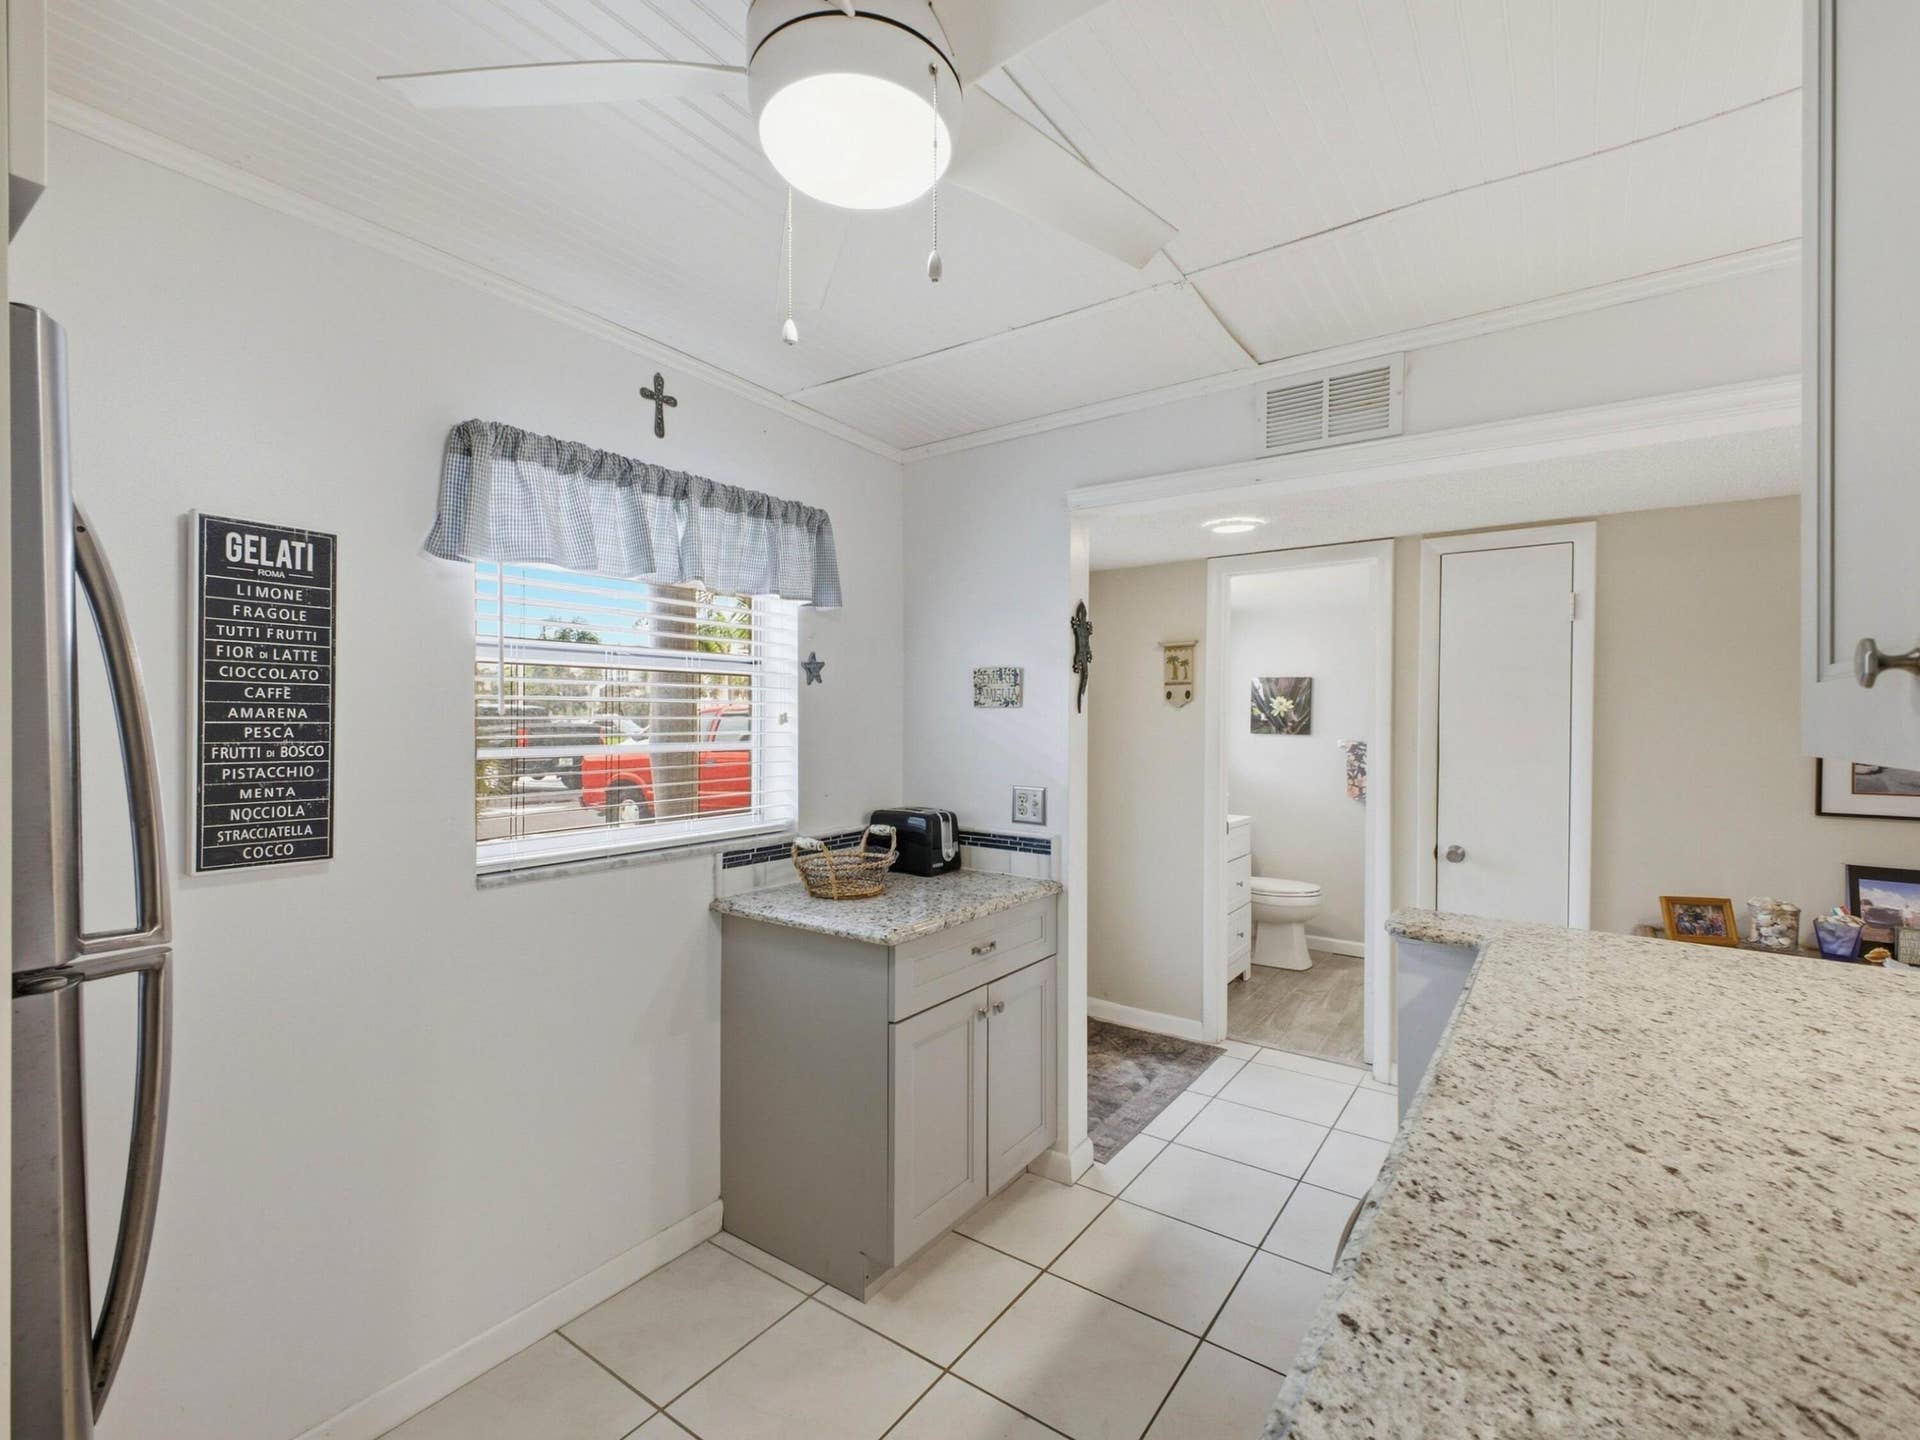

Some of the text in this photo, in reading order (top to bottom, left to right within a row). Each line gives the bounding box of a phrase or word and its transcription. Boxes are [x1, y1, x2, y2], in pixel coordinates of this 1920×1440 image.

[225, 532, 313, 571] GELATI
[258, 568, 285, 578] ROMA
[237, 584, 303, 601] LIMONE
[233, 605, 307, 622] FRAGOLE
[216, 625, 317, 641] TUTTI FRUTTI
[216, 645, 254, 658] FIOR
[273, 648, 318, 662] LATTE
[219, 666, 319, 681] CIOCCOLATO
[227, 707, 308, 719] AMARENA
[244, 727, 294, 738] PESCA
[212, 747, 261, 759] FRUTTI
[280, 745, 324, 758] BOSCO
[222, 765, 314, 780] PISTACCHIO
[240, 787, 296, 799] MENTA
[230, 805, 305, 821] NOCCIOLA
[217, 824, 313, 843] STRACCIATELLA
[242, 843, 294, 859] COCCO
